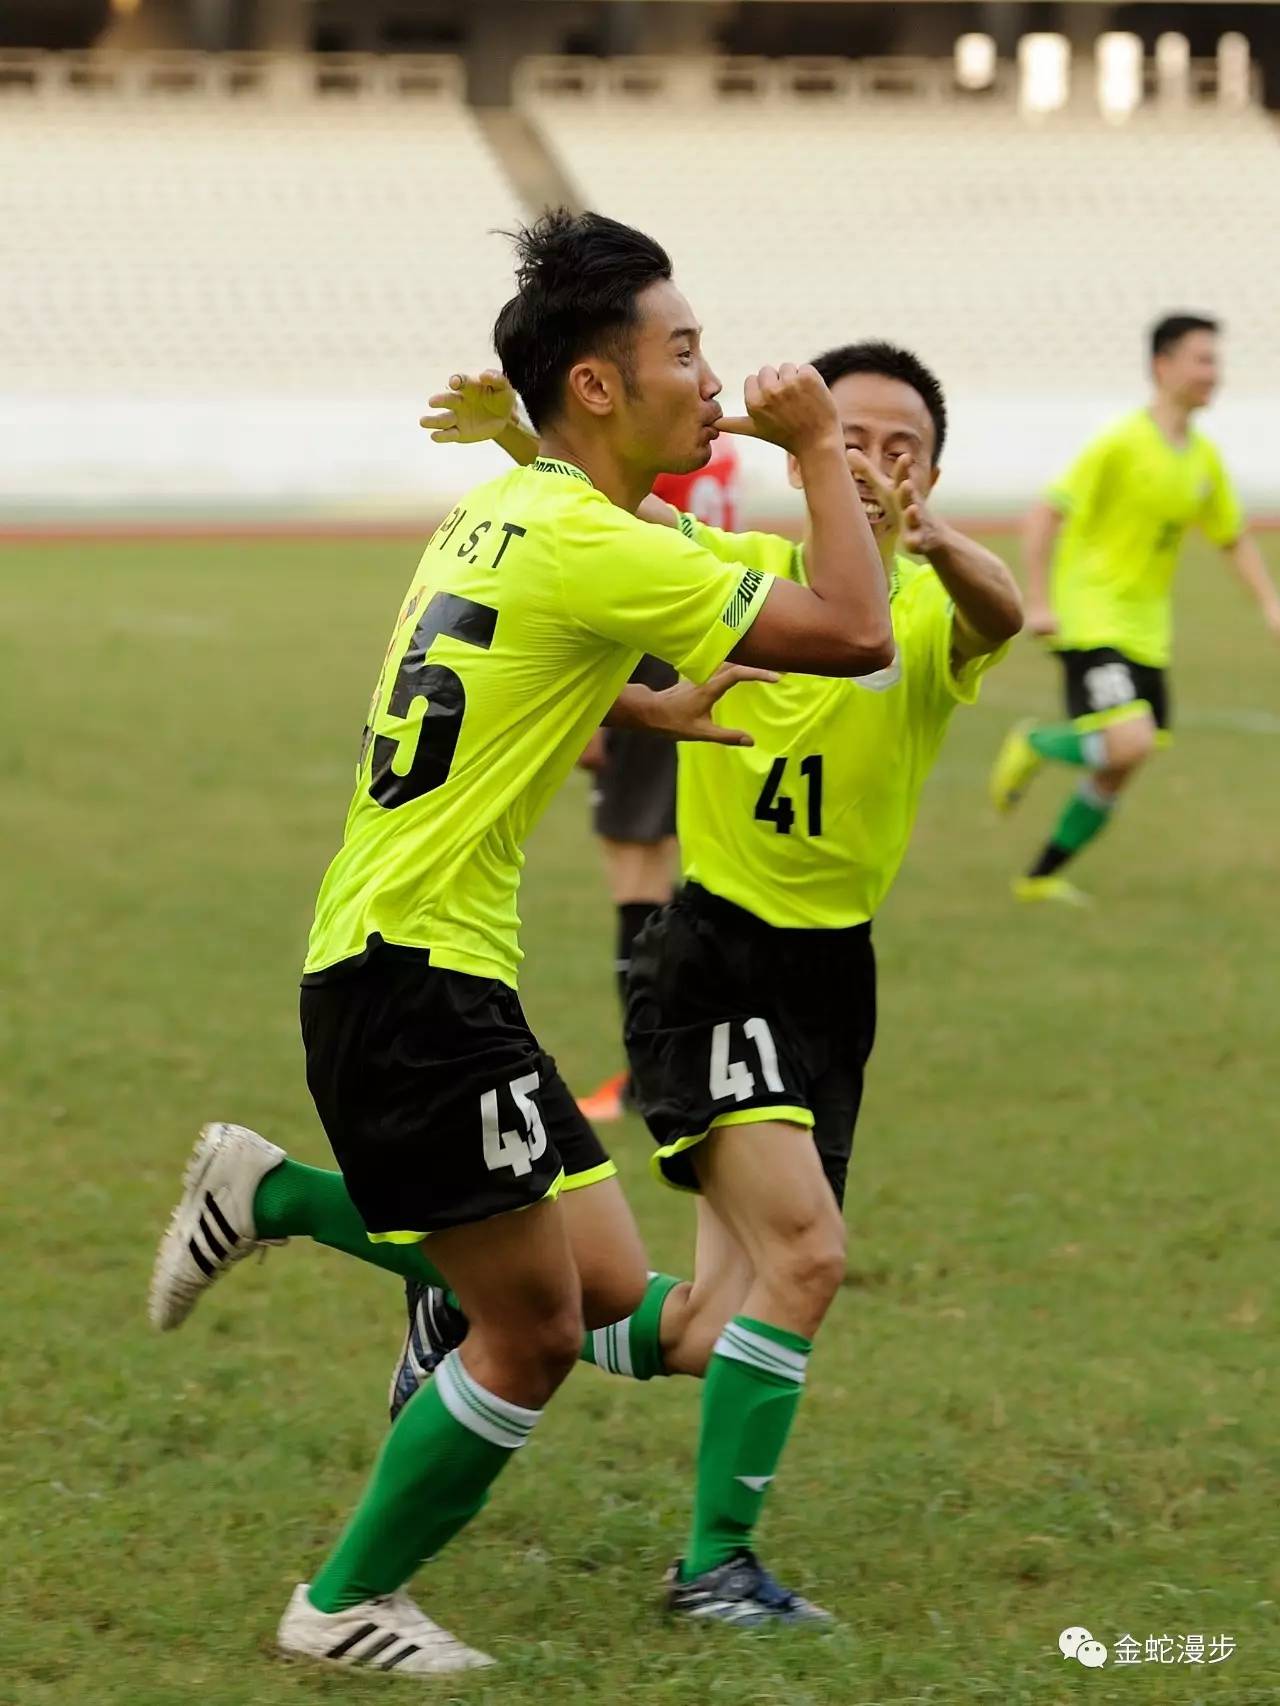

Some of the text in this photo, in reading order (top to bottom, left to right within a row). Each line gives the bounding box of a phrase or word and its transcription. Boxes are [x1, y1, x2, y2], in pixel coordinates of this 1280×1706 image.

[356, 588, 499, 810] 5
[754, 754, 823, 837] 41
[709, 1017, 785, 1102] 41
[480, 1071, 547, 1177] 45
